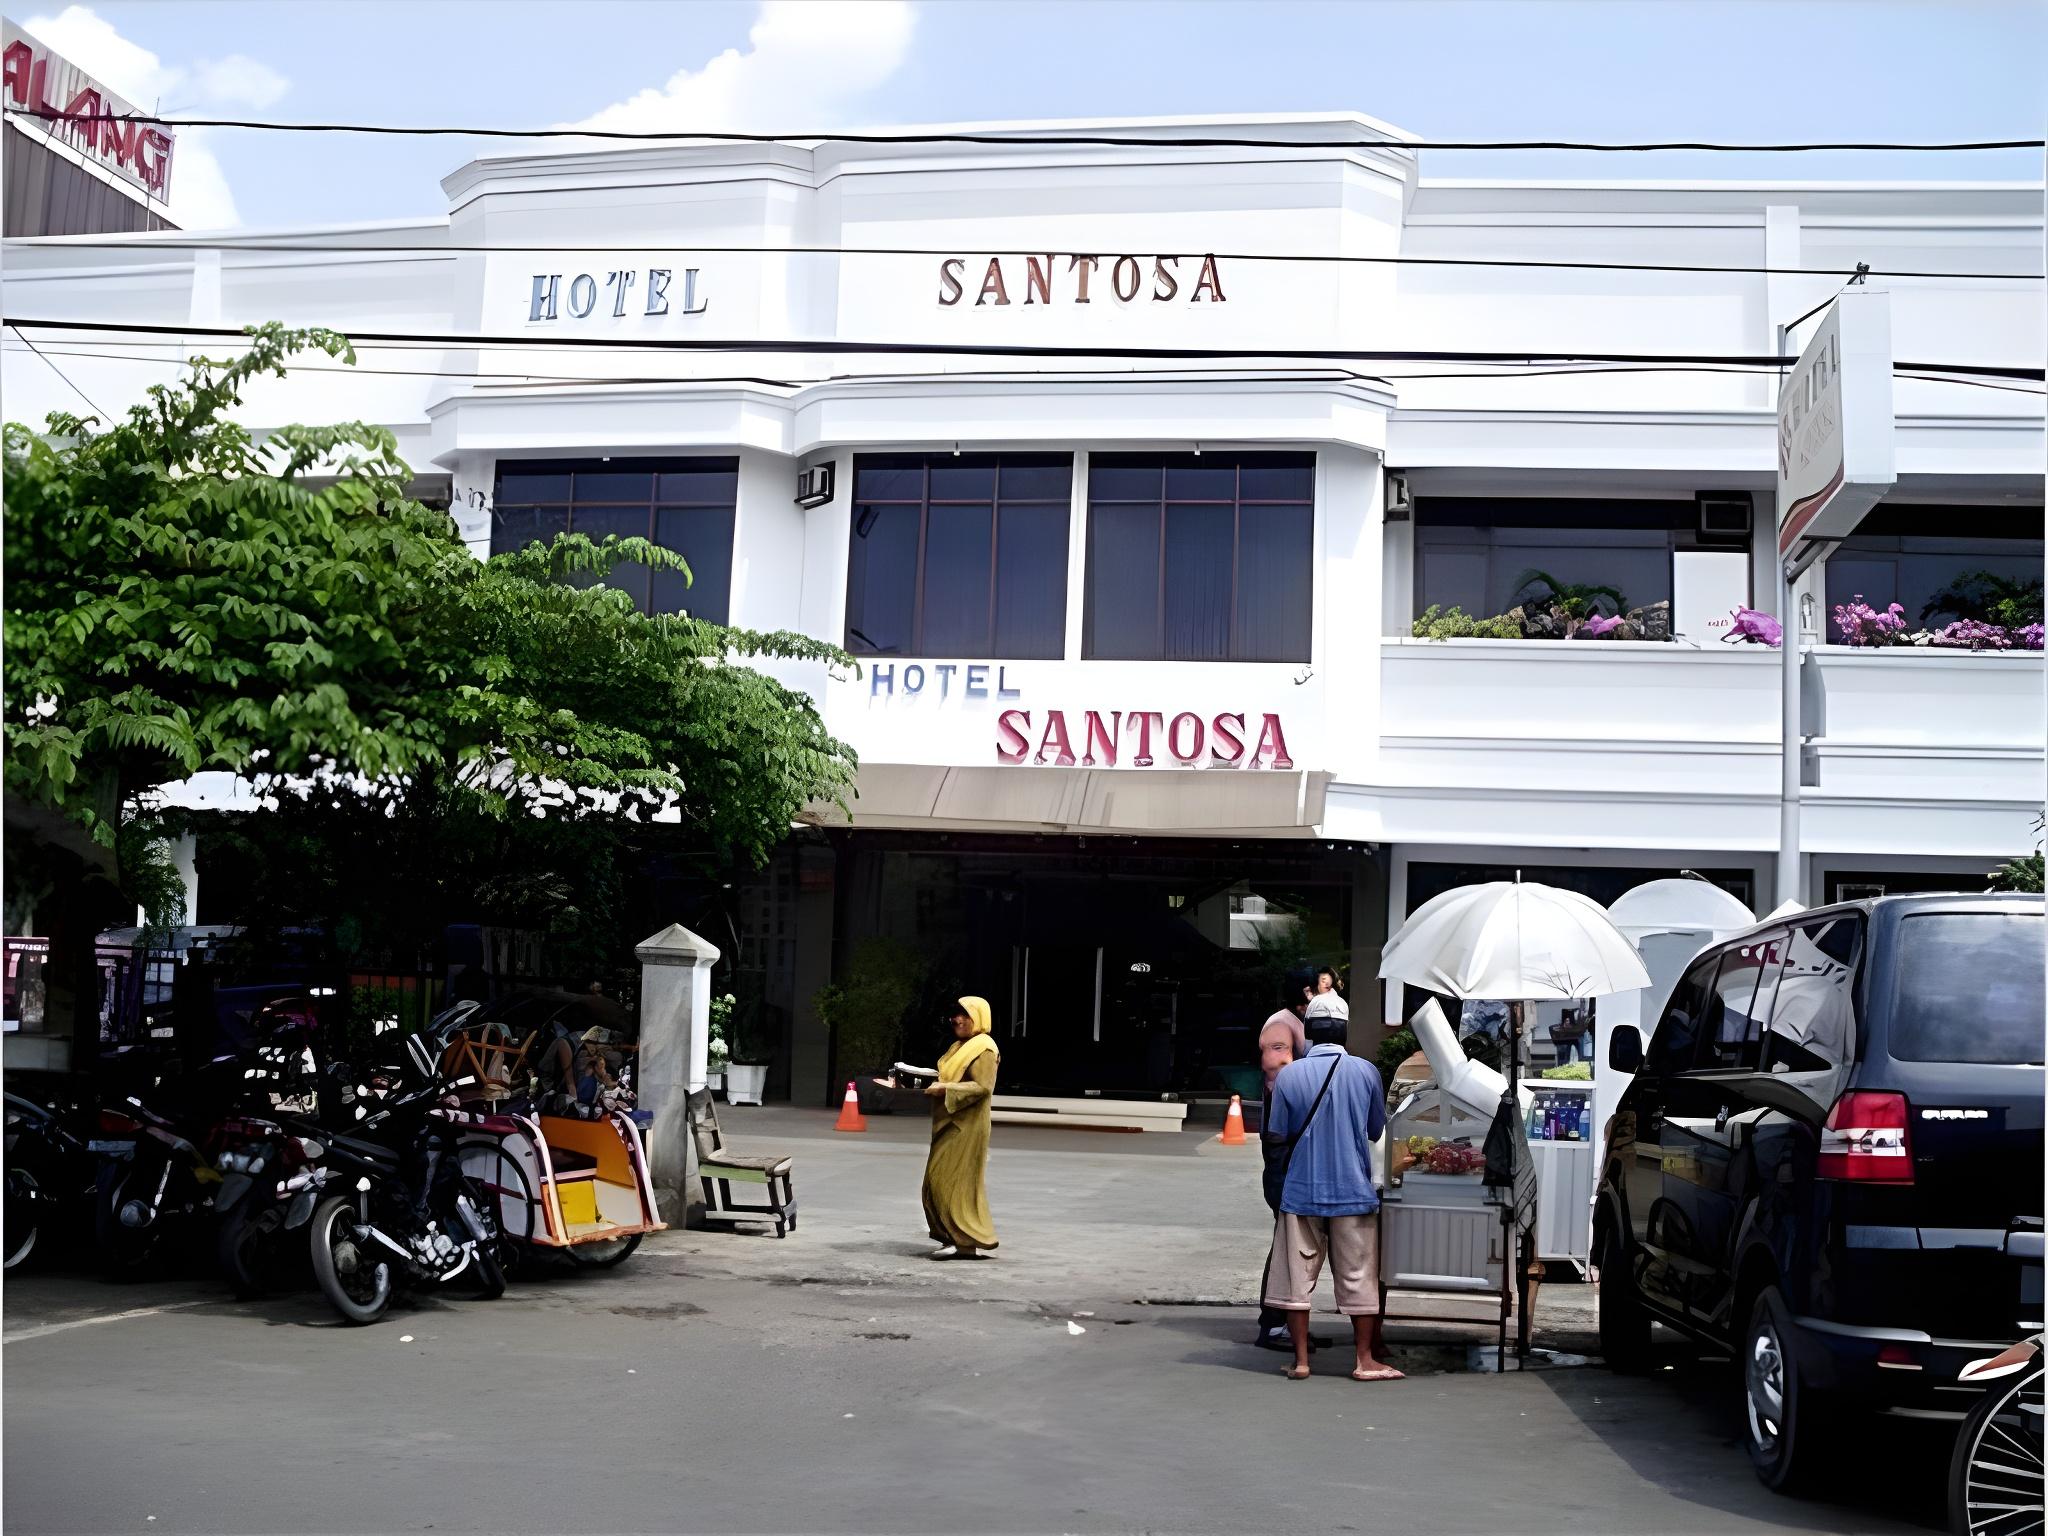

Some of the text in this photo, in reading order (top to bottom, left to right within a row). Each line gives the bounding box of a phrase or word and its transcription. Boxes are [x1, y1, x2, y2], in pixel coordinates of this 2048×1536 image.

[528, 252, 1227, 322] HOTEL SANTOSA
[870, 663, 1021, 698] HOTEL
[996, 709, 1294, 770] SANTOSA
